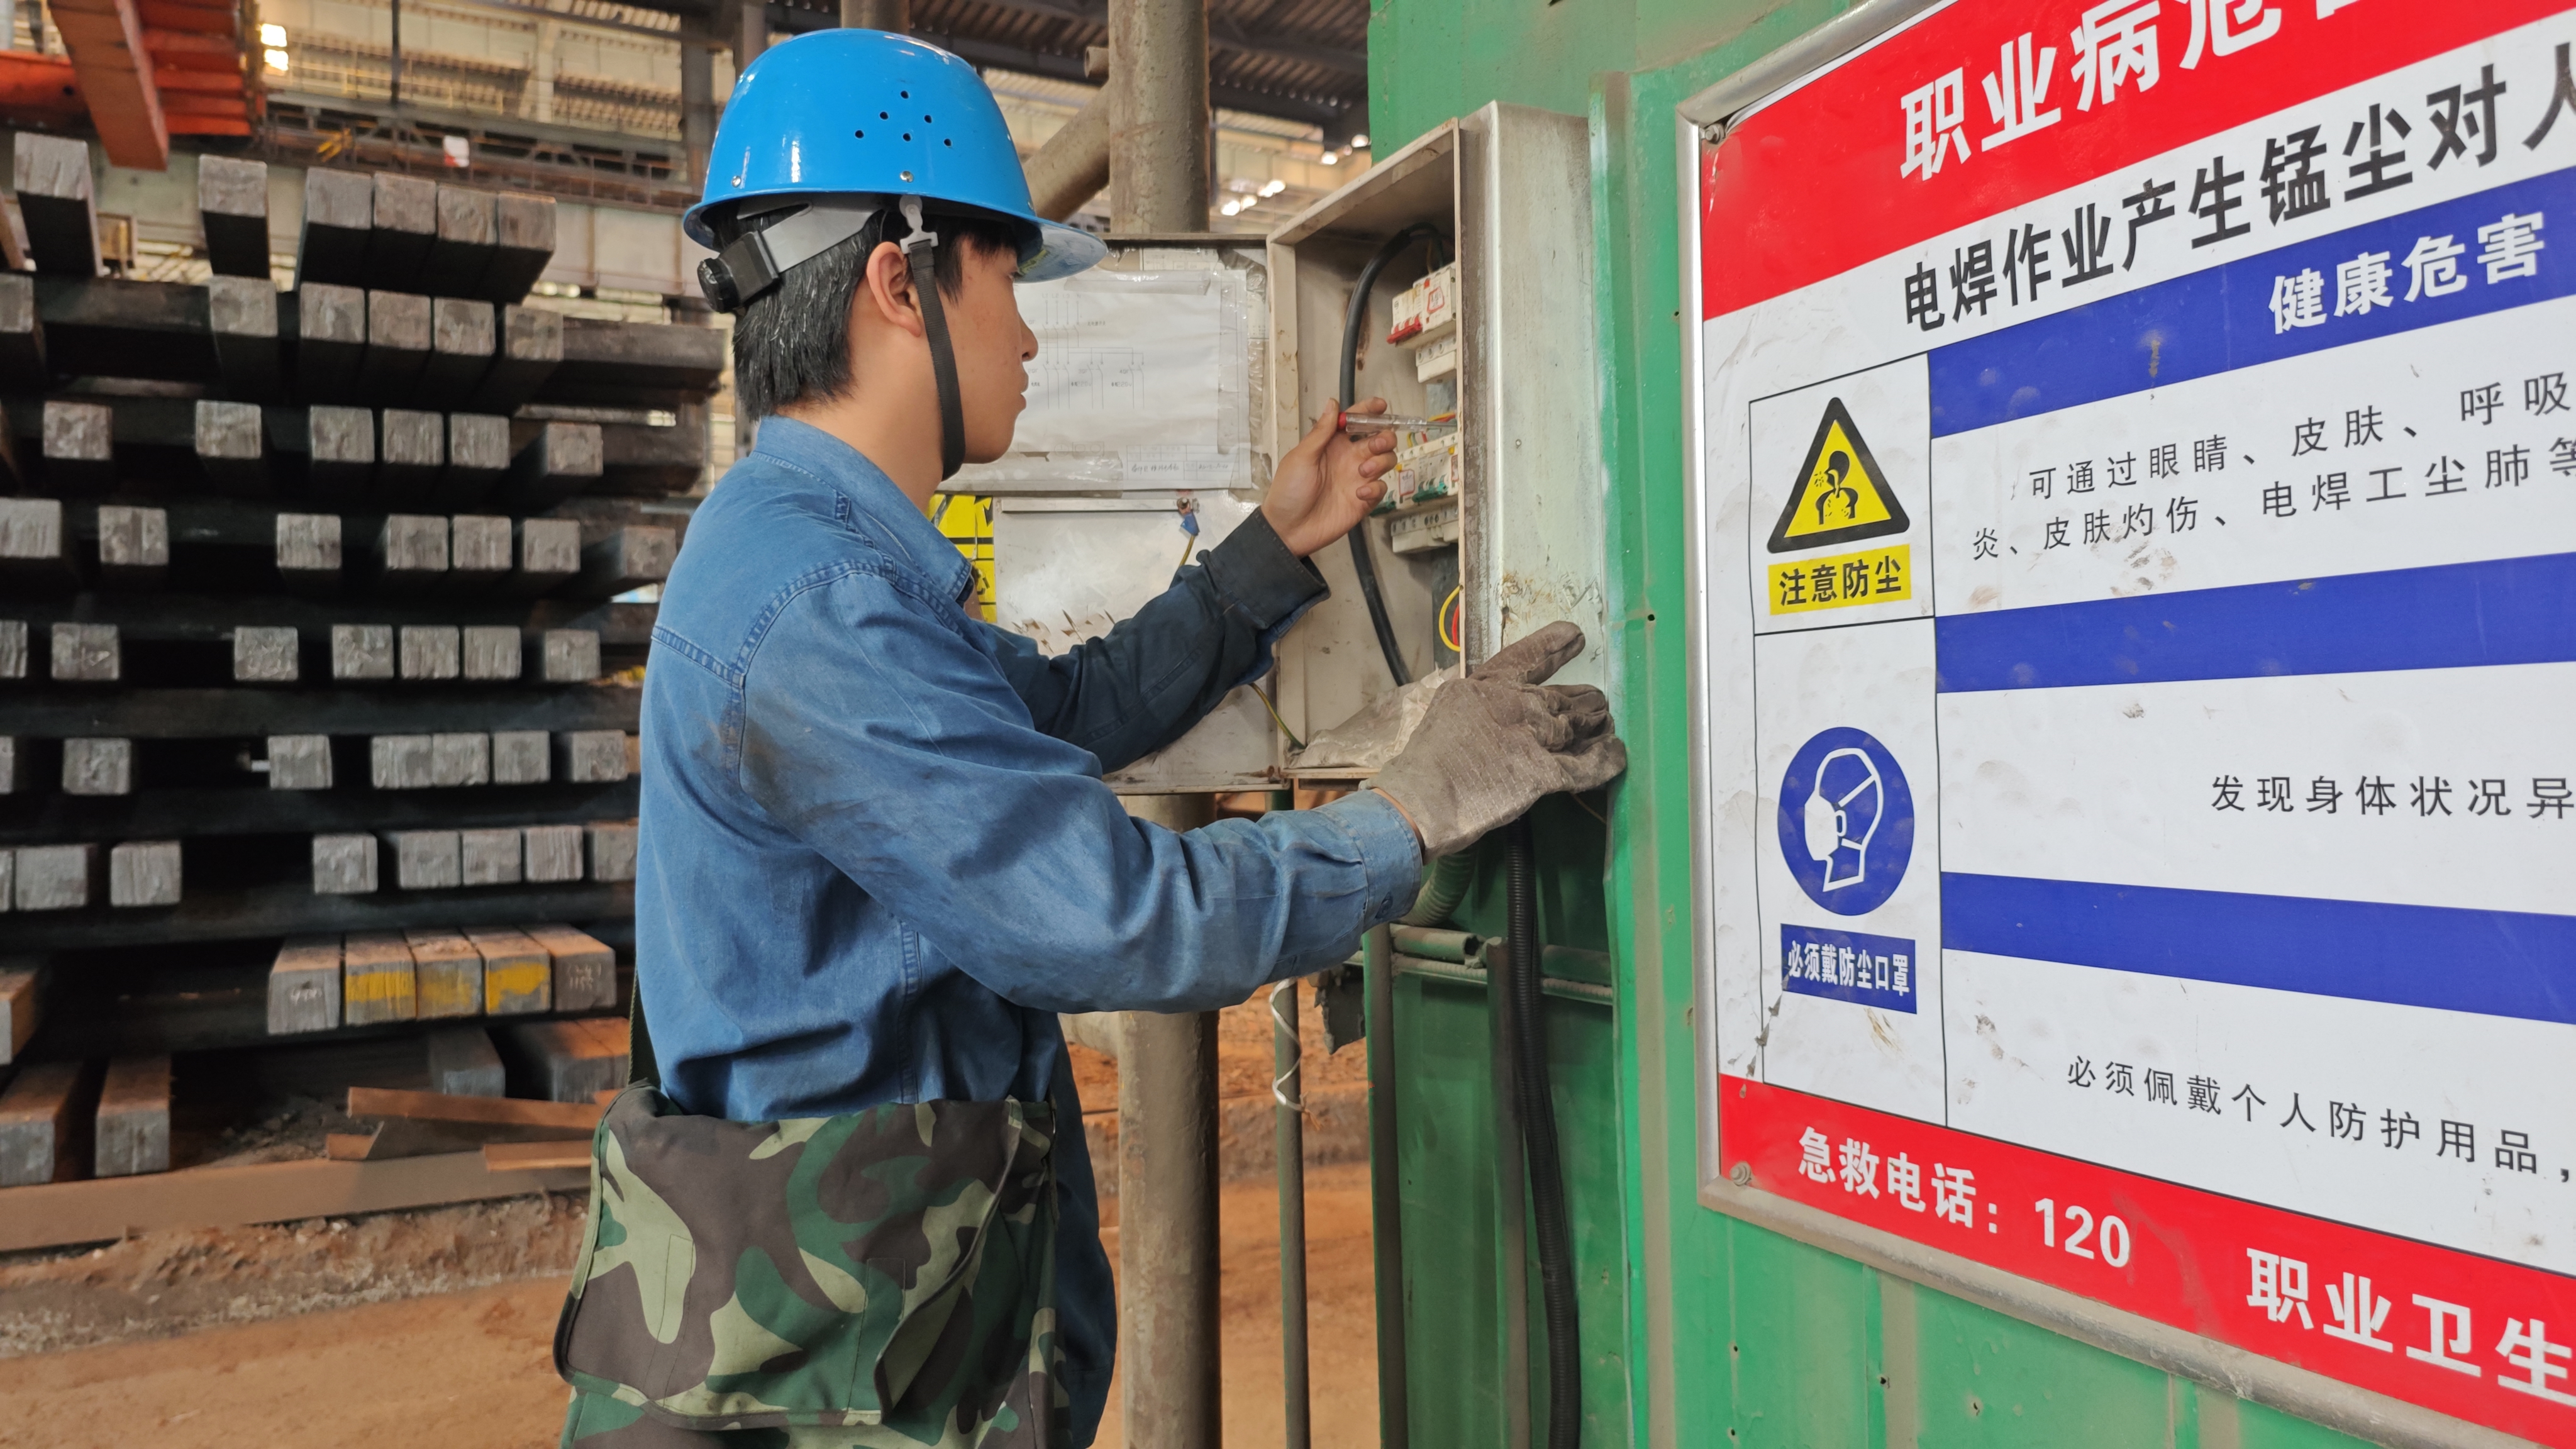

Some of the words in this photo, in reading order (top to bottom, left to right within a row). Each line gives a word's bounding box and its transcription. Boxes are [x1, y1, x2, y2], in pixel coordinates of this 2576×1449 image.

[1901, 0, 2360, 181] 职业病危
[1905, 42, 2576, 331] 电焊作业产生锰尘对人
[2268, 211, 2545, 333] 健康危害
[2029, 371, 2571, 499] 可通过眼睛、皮肤、呼吸
[1779, 556, 1902, 606] 注意防尘
[2211, 775, 2574, 819] 发现身体状况异
[1788, 940, 1910, 996] 必须戴防尘口罩
[2246, 1247, 2576, 1407] 职业卫生
